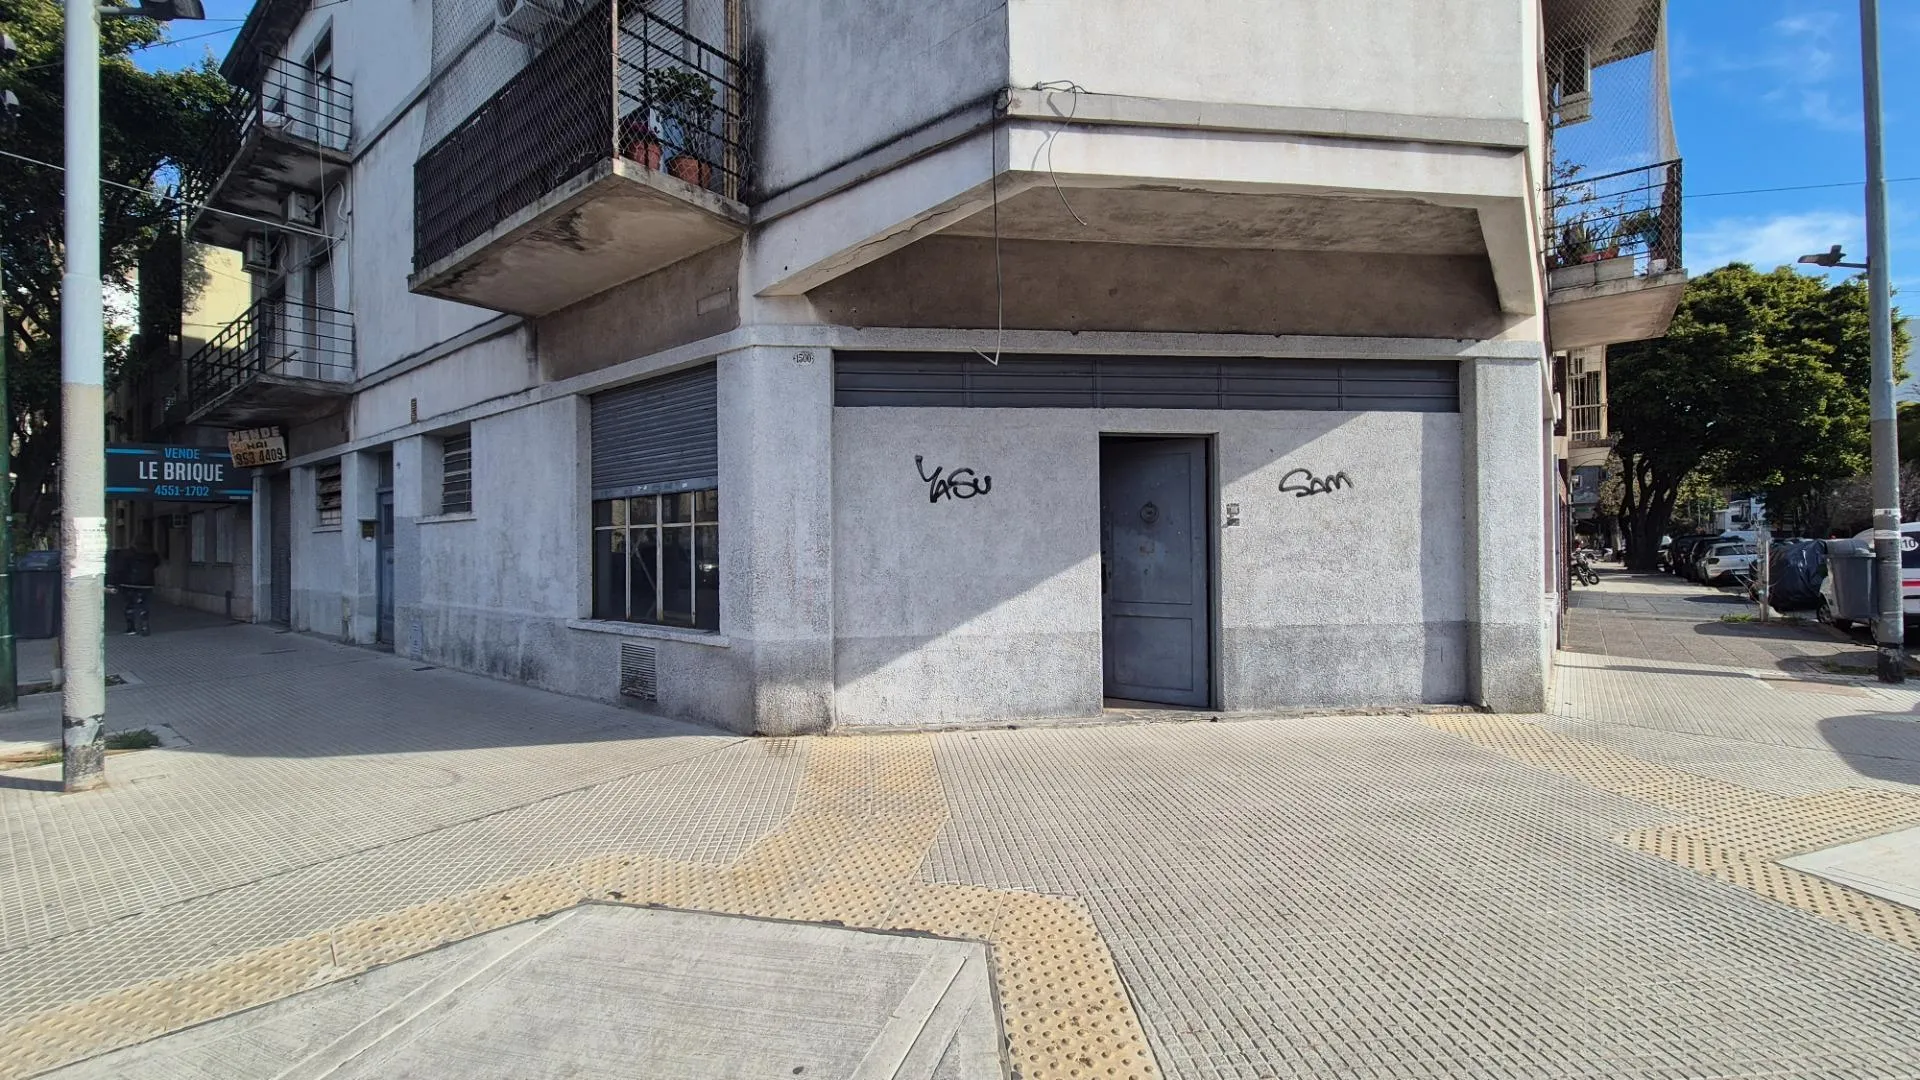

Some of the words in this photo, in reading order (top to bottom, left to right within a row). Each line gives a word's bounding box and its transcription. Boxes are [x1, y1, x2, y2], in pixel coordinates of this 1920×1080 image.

[164, 447, 201, 460] VENDE
[139, 460, 159, 480] LE
[163, 461, 224, 483] BRIQUE
[154, 484, 210, 497] 4551-1702
